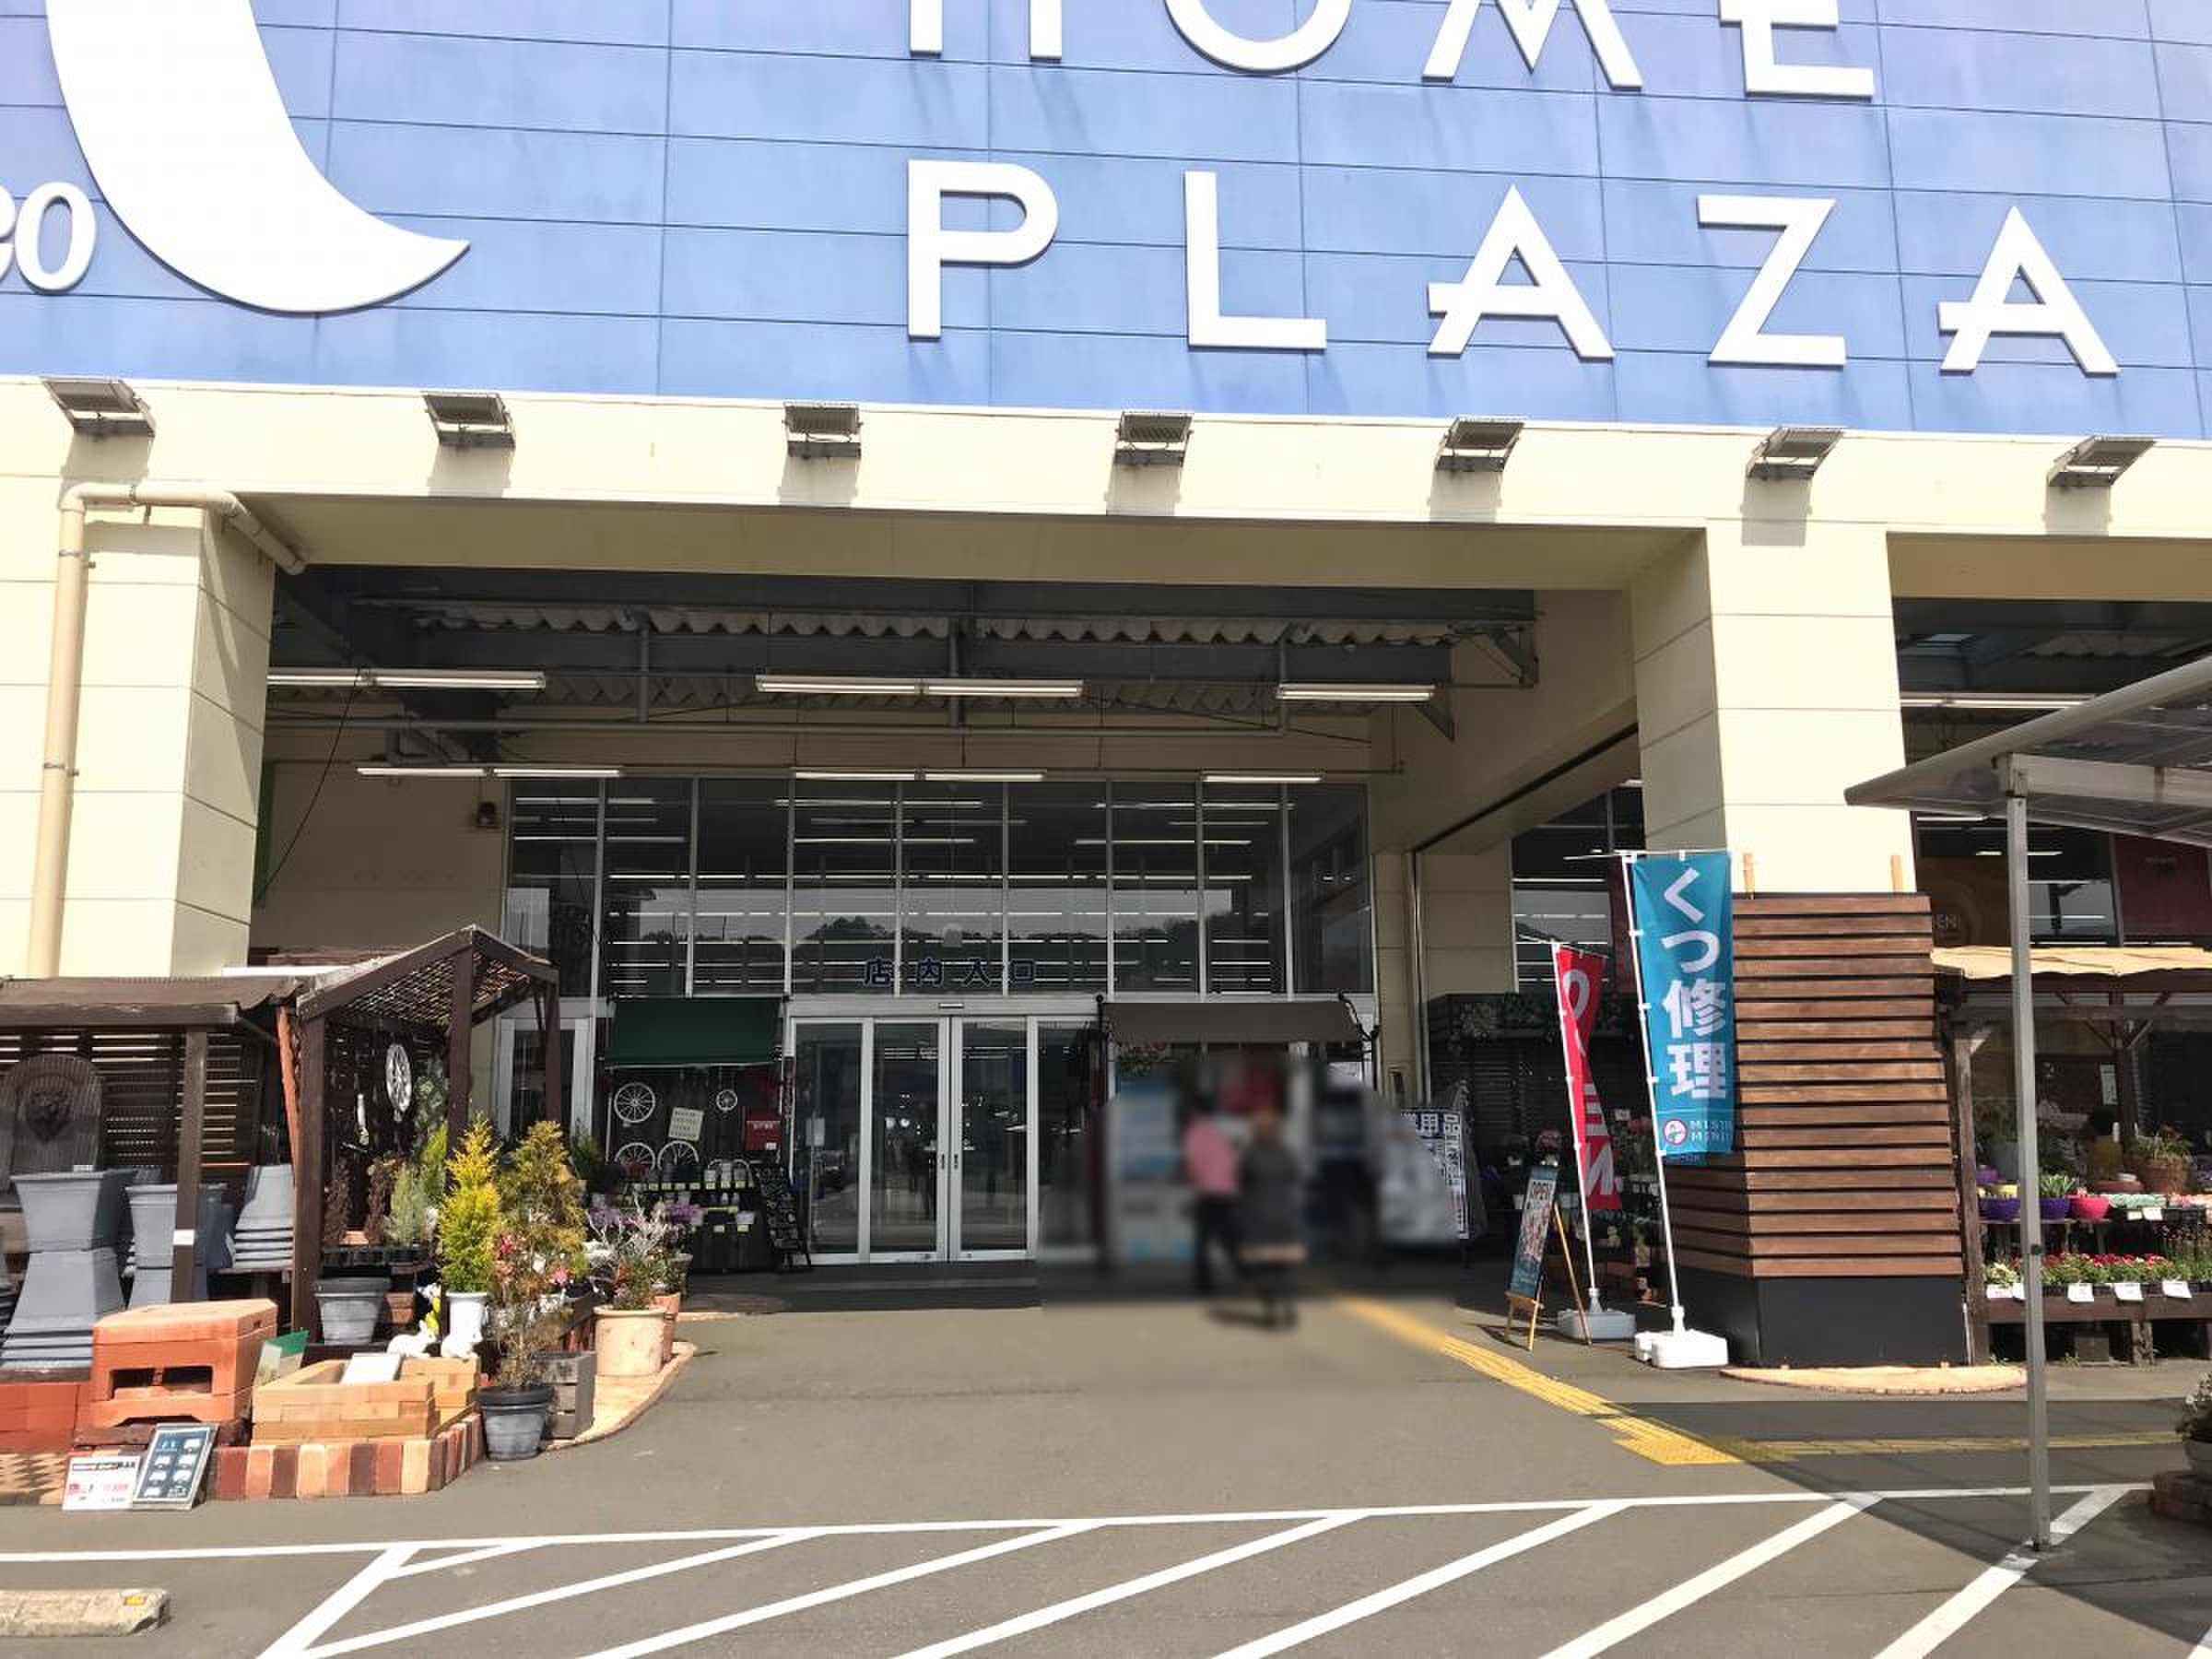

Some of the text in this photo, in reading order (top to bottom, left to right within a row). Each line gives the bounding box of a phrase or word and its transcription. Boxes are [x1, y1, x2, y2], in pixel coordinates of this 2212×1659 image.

[907, 159, 2121, 375] PLAZA
[862, 956, 1034, 987] 店内入口
[1662, 867, 1726, 1099] くつ修理
